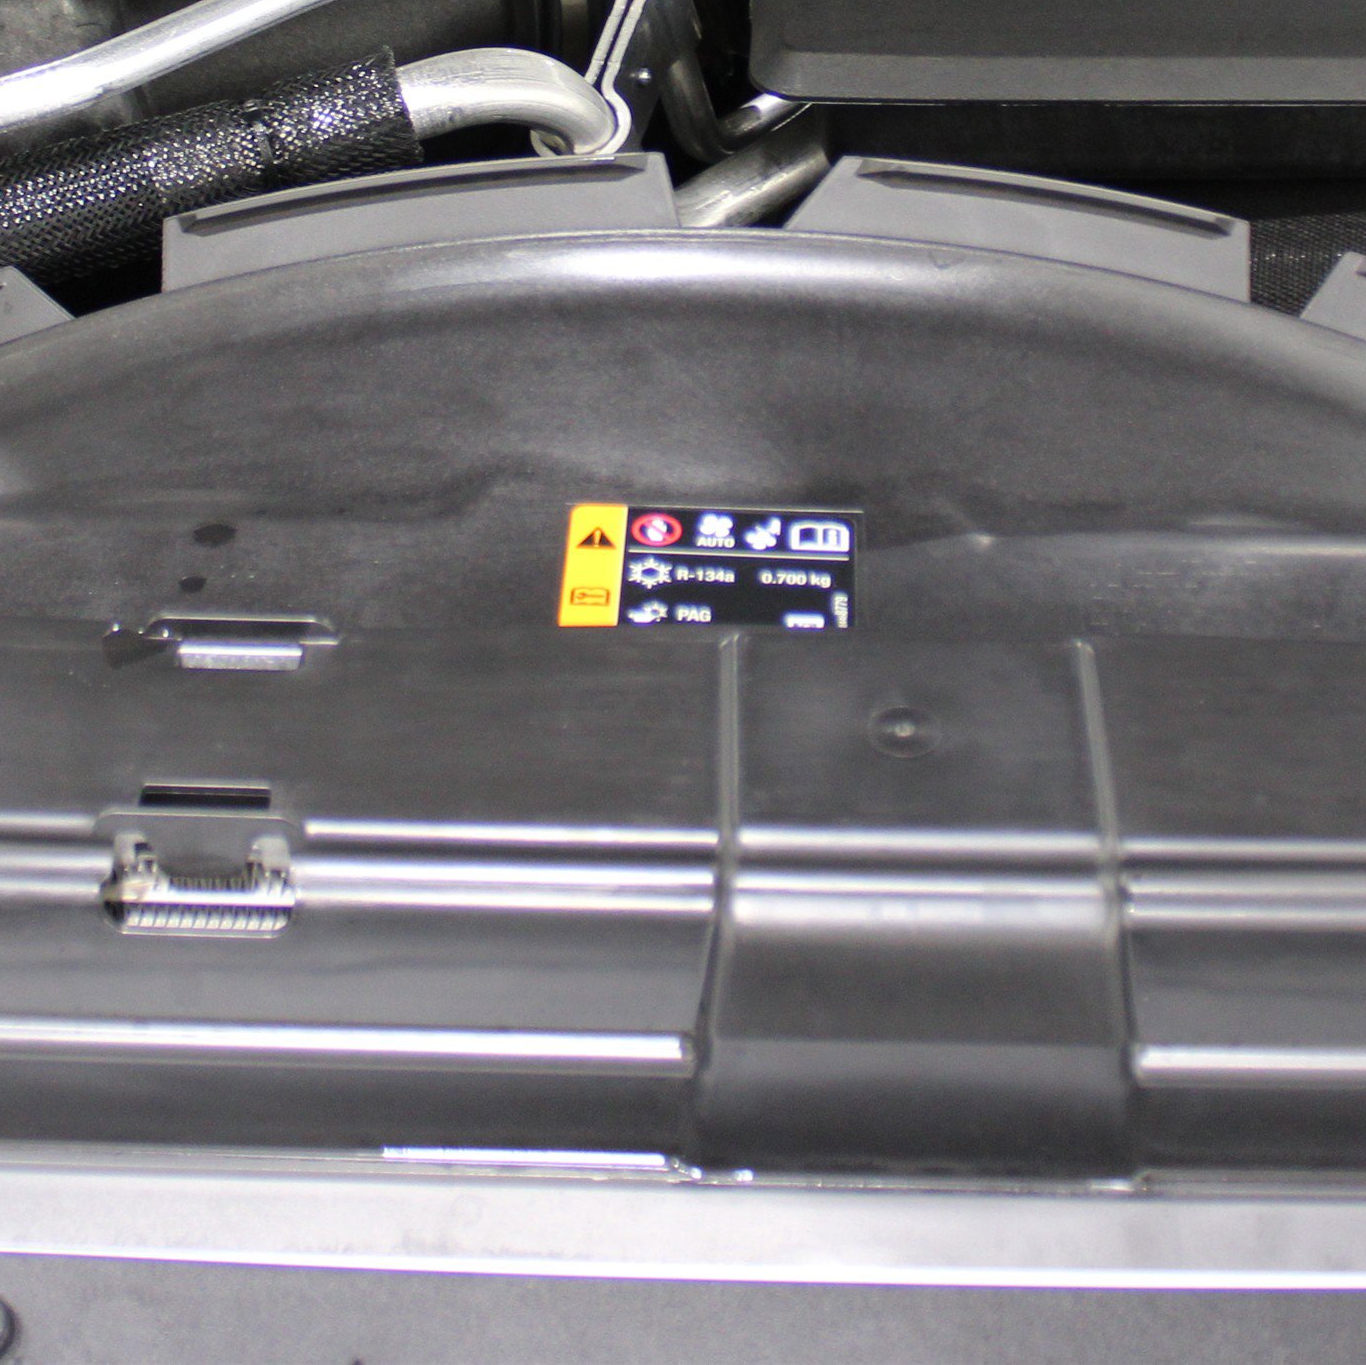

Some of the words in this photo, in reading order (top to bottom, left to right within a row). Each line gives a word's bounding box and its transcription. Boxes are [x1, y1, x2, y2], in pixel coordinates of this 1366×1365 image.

[696, 535, 735, 549] AUTO
[676, 566, 735, 584] R-134a
[760, 569, 807, 585] 0.700
[809, 570, 832, 589] kg
[677, 606, 712, 623] PAG
